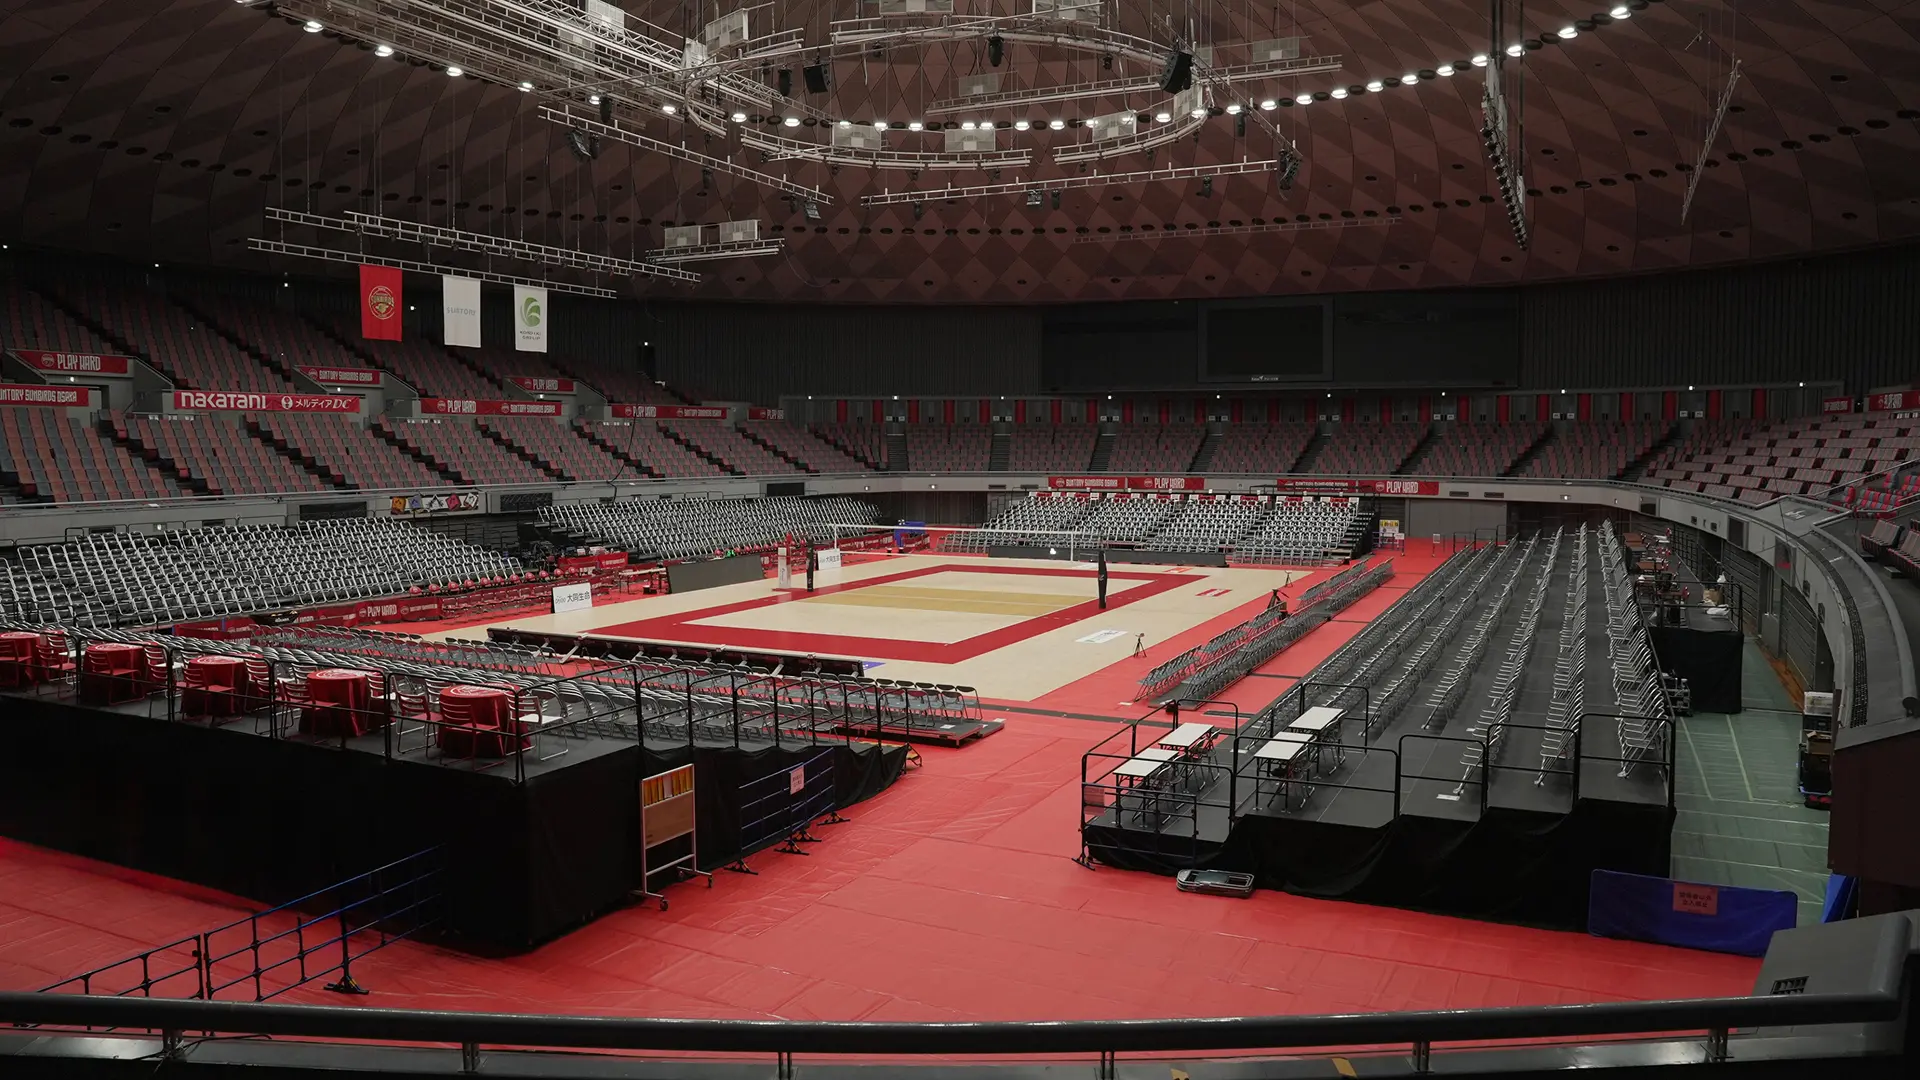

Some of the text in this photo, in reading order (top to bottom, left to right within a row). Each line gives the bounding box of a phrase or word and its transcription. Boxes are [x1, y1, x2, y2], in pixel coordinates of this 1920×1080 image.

[446, 307, 476, 316] SUNTORY
[57, 354, 101, 371] PLAY HARD
[533, 379, 545, 391] PLAY
[25, 389, 56, 402] SUNBIRDS
[57, 390, 77, 403] OSAKA
[295, 399, 352, 409] メルディア DC
[447, 400, 477, 413] PLAY HARD
[1066, 478, 1084, 487] SUNTORY
[1154, 478, 1185, 489] PLAY HARD
[1386, 481, 1419, 493] PLAY HARD
[567, 591, 590, 603] 大同生命
[367, 605, 381, 617] PLAY
[381, 604, 398, 616] HARD
